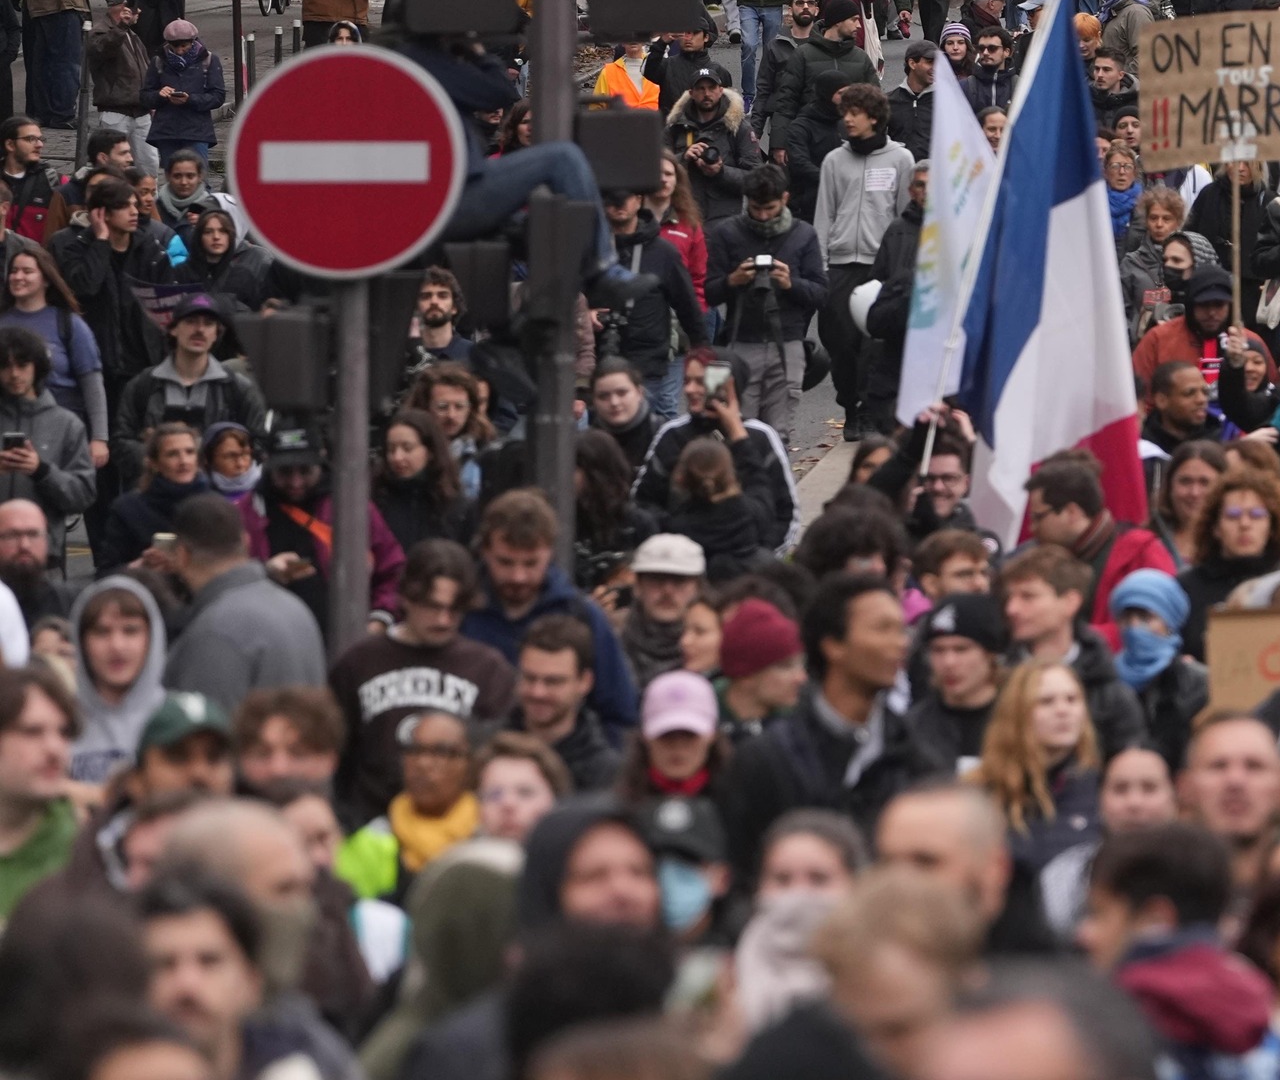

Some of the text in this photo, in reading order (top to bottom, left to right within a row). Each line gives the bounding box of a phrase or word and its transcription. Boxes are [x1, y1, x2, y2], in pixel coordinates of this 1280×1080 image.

[1151, 29, 1200, 73] ON
[1221, 21, 1272, 67] EN
[1215, 64, 1274, 88] TOUS
